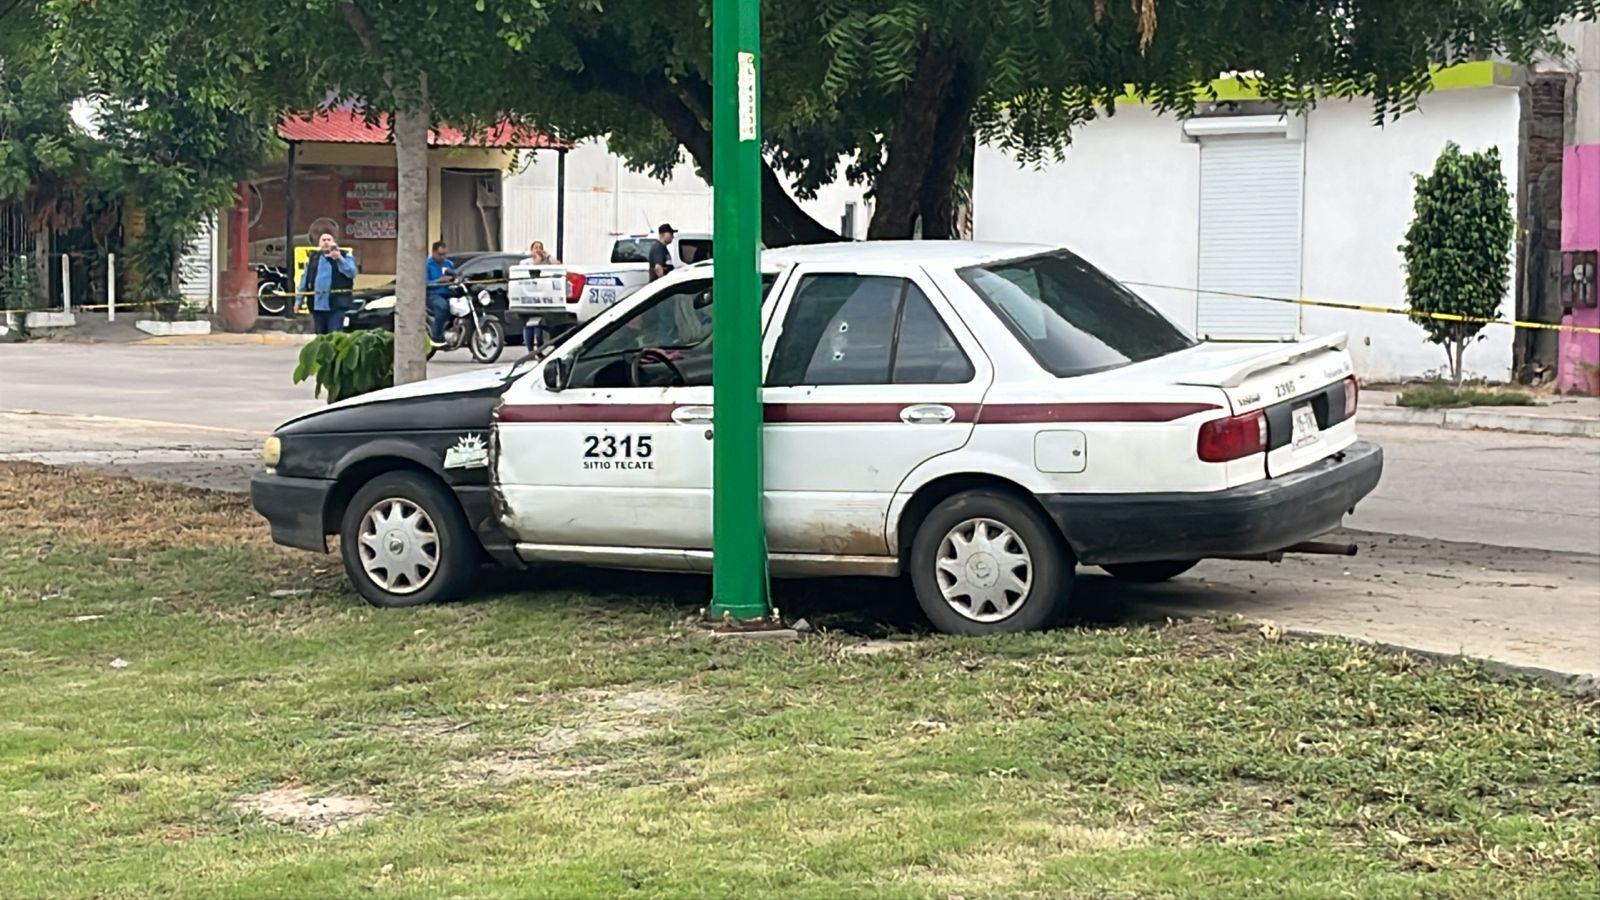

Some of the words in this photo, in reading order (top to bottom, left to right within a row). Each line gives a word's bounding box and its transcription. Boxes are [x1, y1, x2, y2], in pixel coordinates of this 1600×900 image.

[1275, 380, 1297, 398] 2315
[584, 435, 652, 458] 2315
[583, 460, 611, 470] SITIO
[615, 460, 655, 470] TECATE
